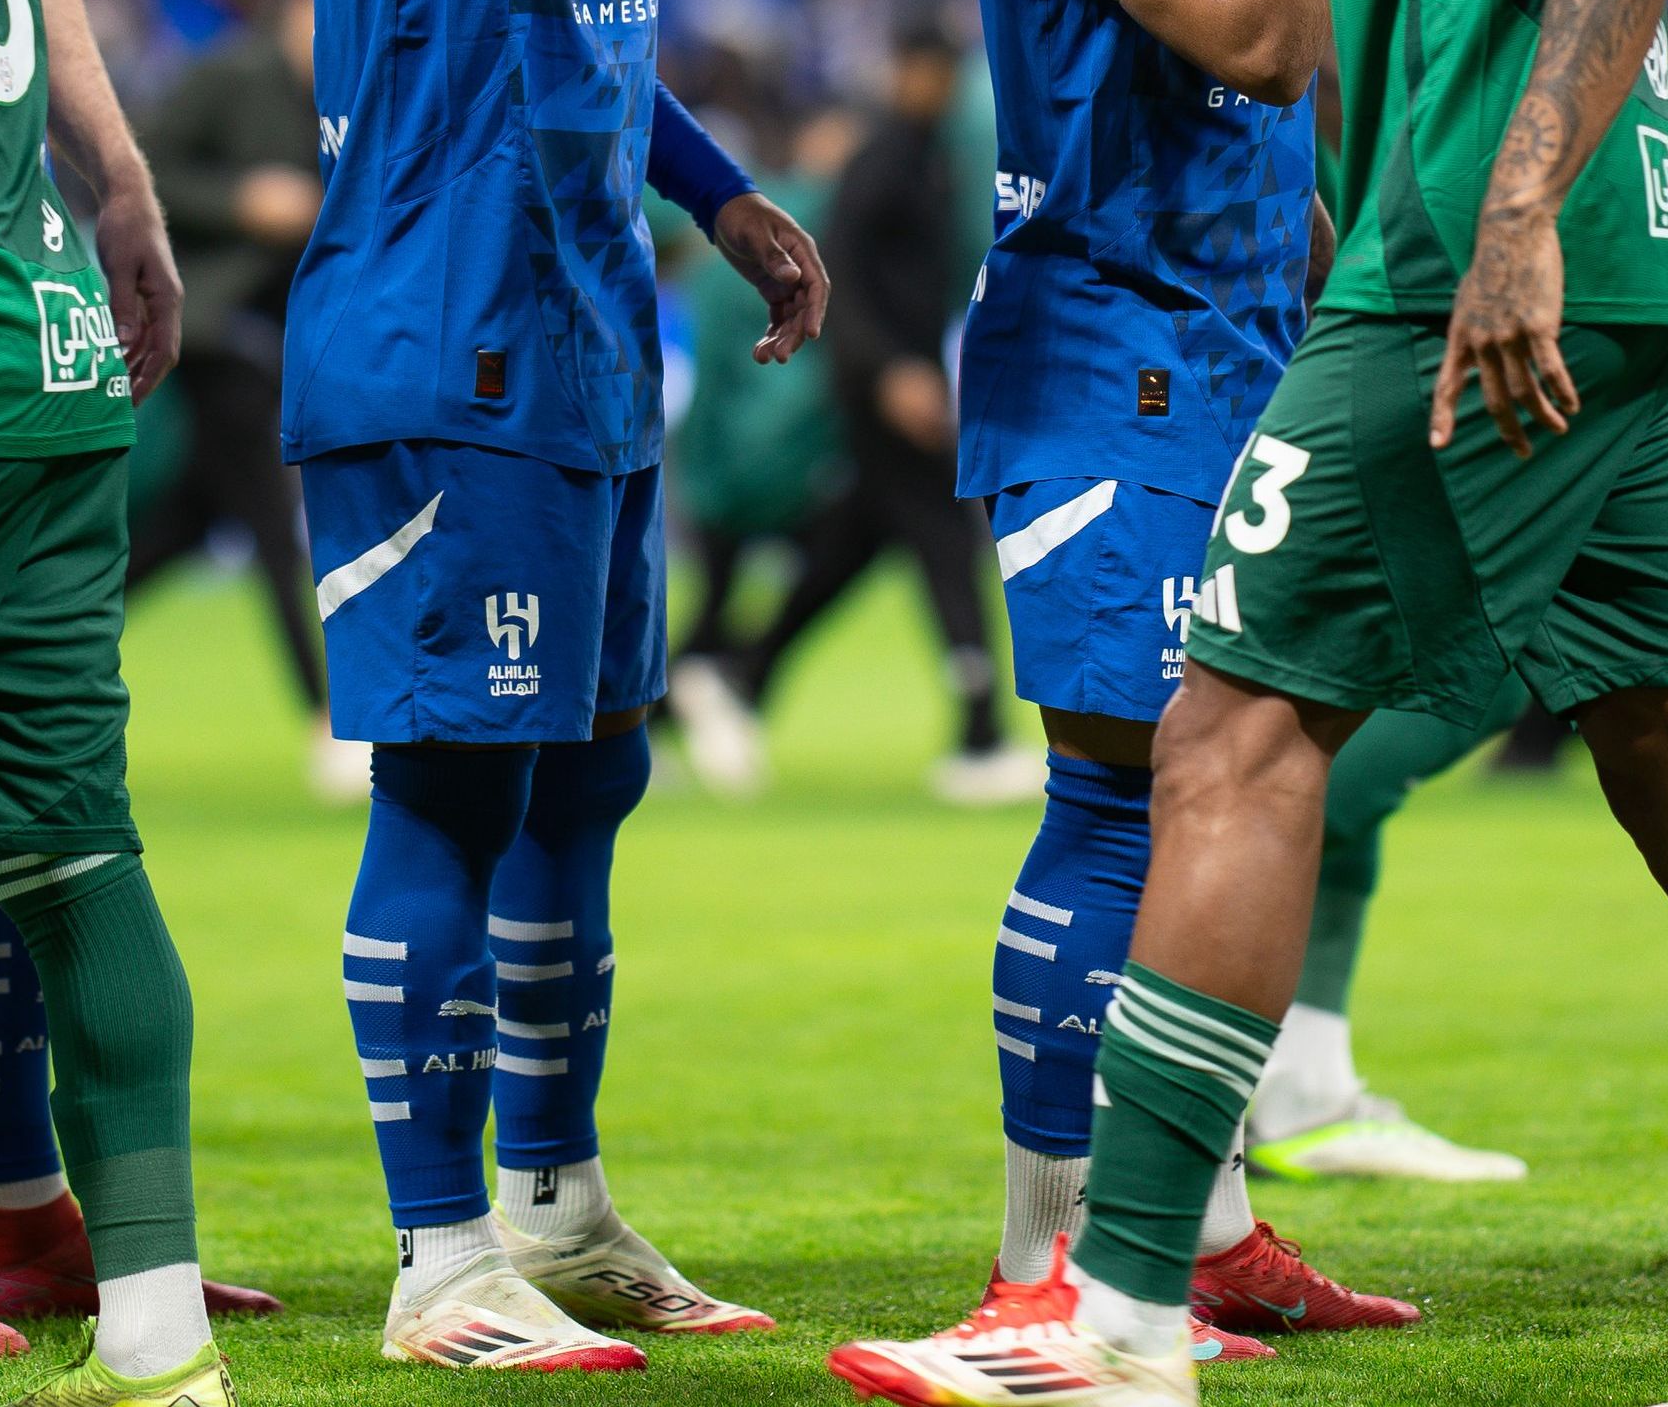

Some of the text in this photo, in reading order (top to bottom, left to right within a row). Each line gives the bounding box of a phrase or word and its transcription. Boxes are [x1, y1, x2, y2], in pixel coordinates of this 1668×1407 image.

[1216, 433, 1311, 554] 3
[488, 665, 541, 680] ALHILAL
[490, 680, 540, 697] الهلال
[1057, 1014, 1104, 1035] AL
[423, 1053, 465, 1074] AL
